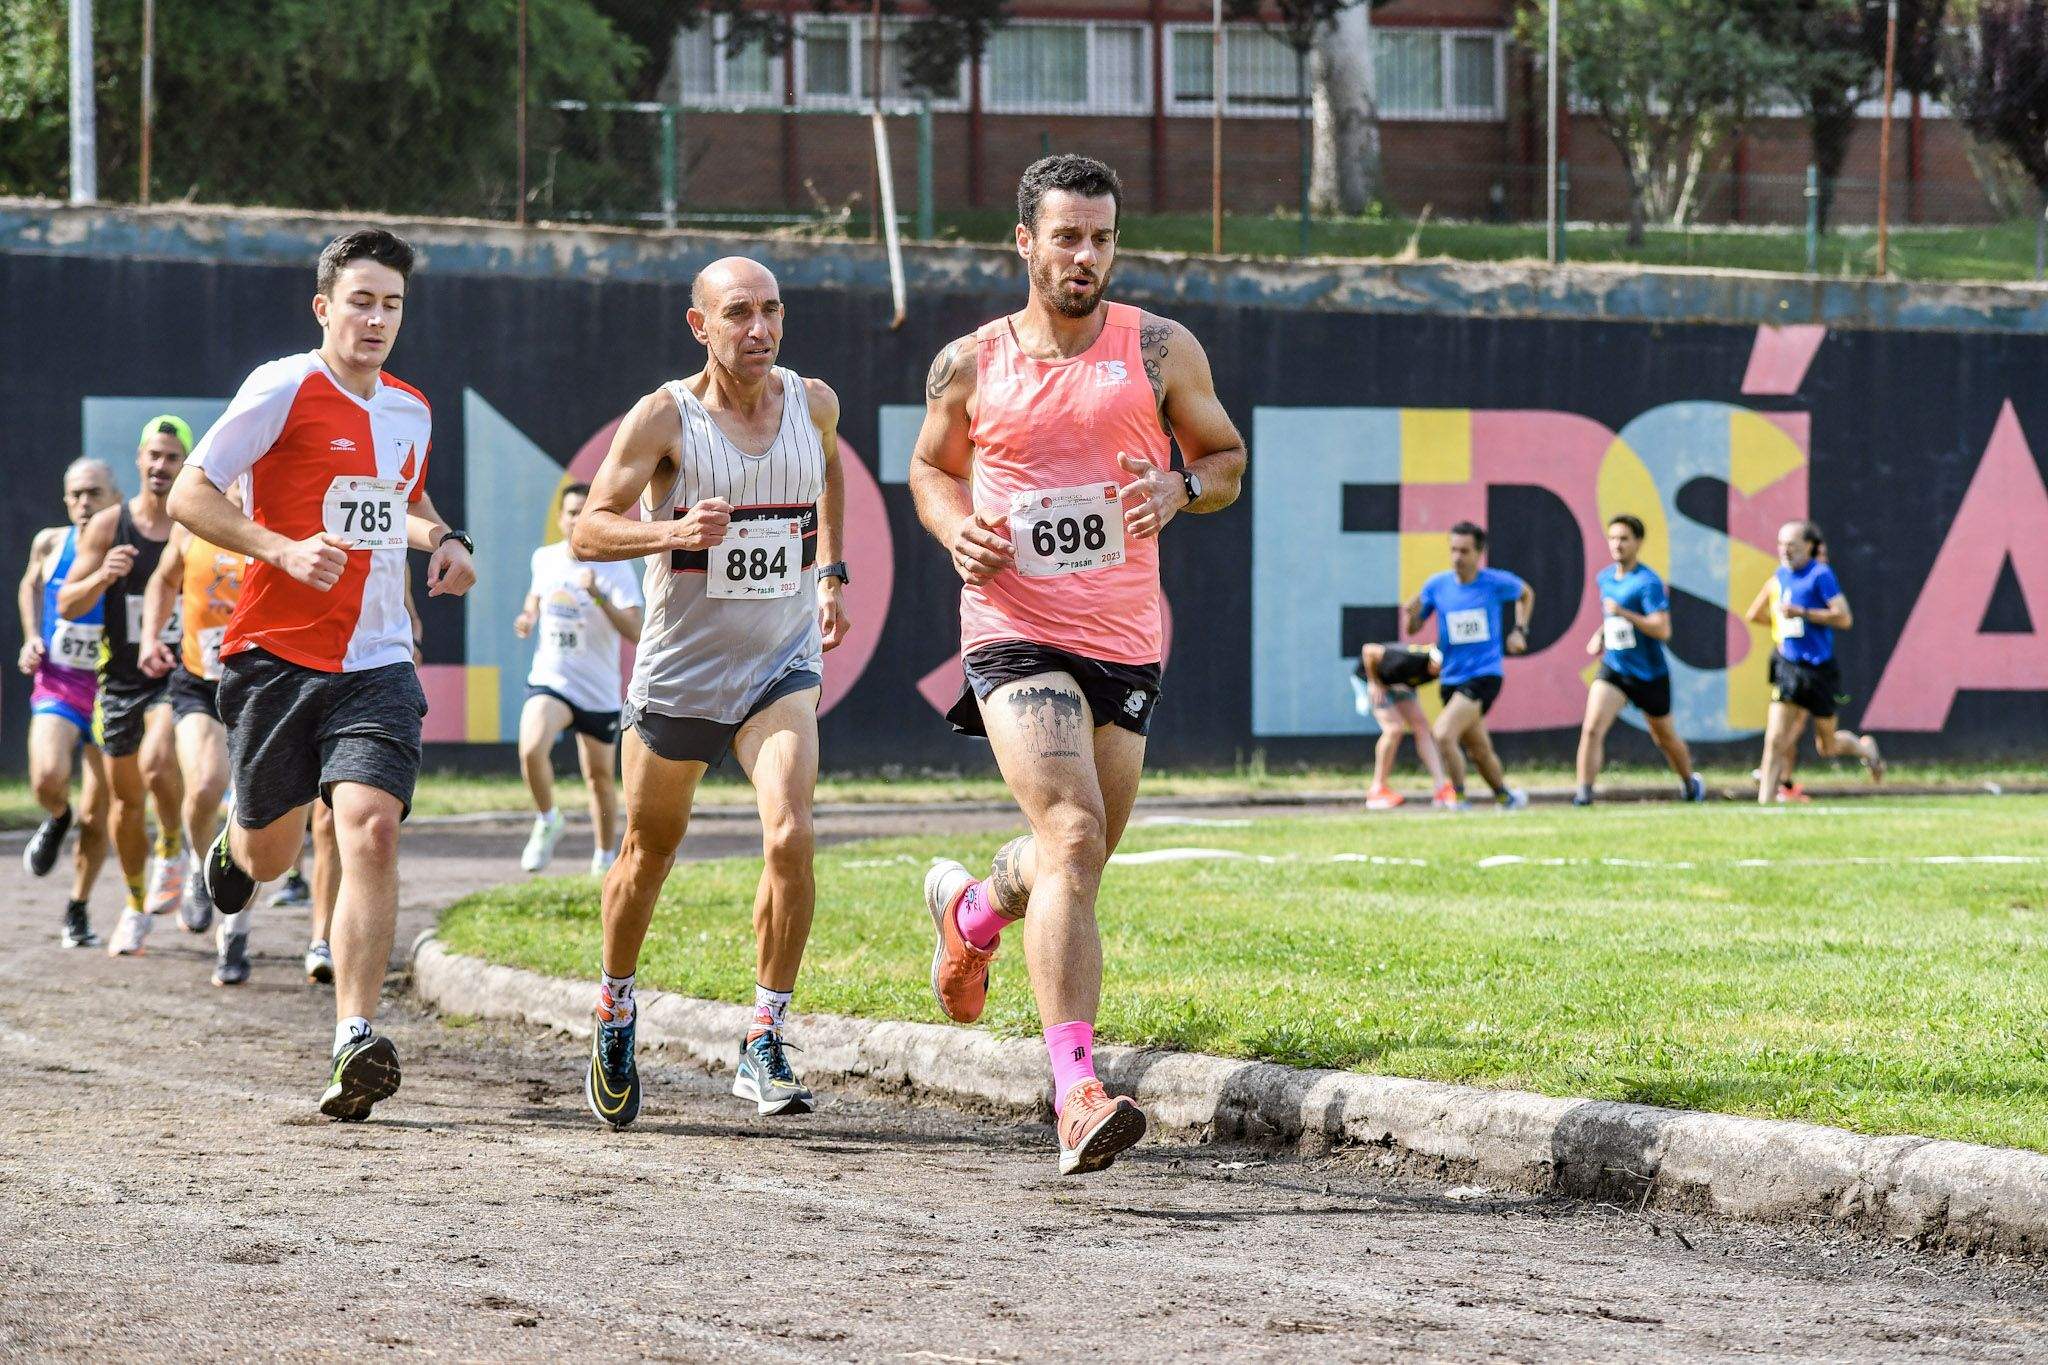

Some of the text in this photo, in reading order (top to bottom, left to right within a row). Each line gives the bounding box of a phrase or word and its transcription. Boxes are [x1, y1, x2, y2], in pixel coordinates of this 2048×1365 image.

[340, 501, 391, 532] 785
[1032, 514, 1106, 557] 698
[726, 547, 788, 581] 884
[1070, 551, 1121, 569] rasán 2023
[757, 582, 796, 595] rasán 2023
[63, 637, 98, 659] 875
